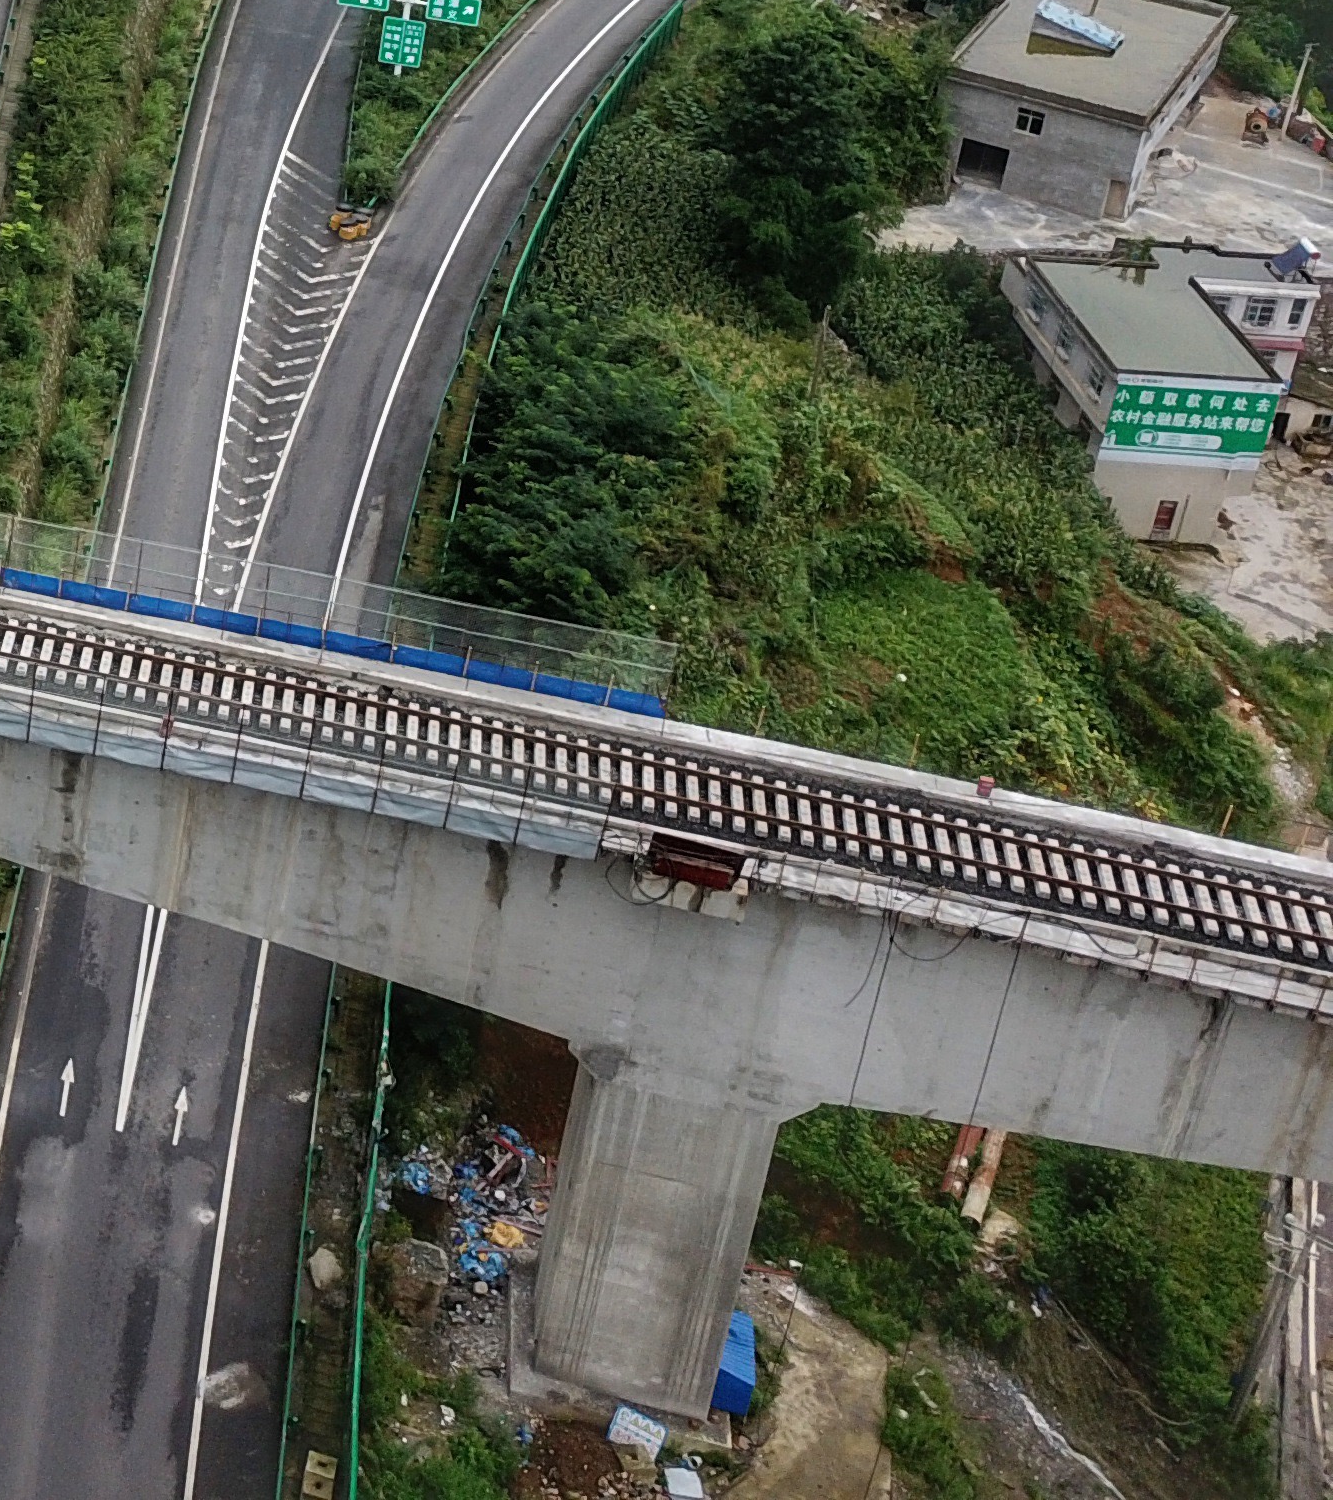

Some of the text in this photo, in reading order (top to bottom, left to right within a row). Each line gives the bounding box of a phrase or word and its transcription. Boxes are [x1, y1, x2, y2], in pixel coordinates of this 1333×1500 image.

[1115, 388, 1272, 413] 小额取款何处去
[1110, 408, 1266, 434] 农村金融服务站来帮您
